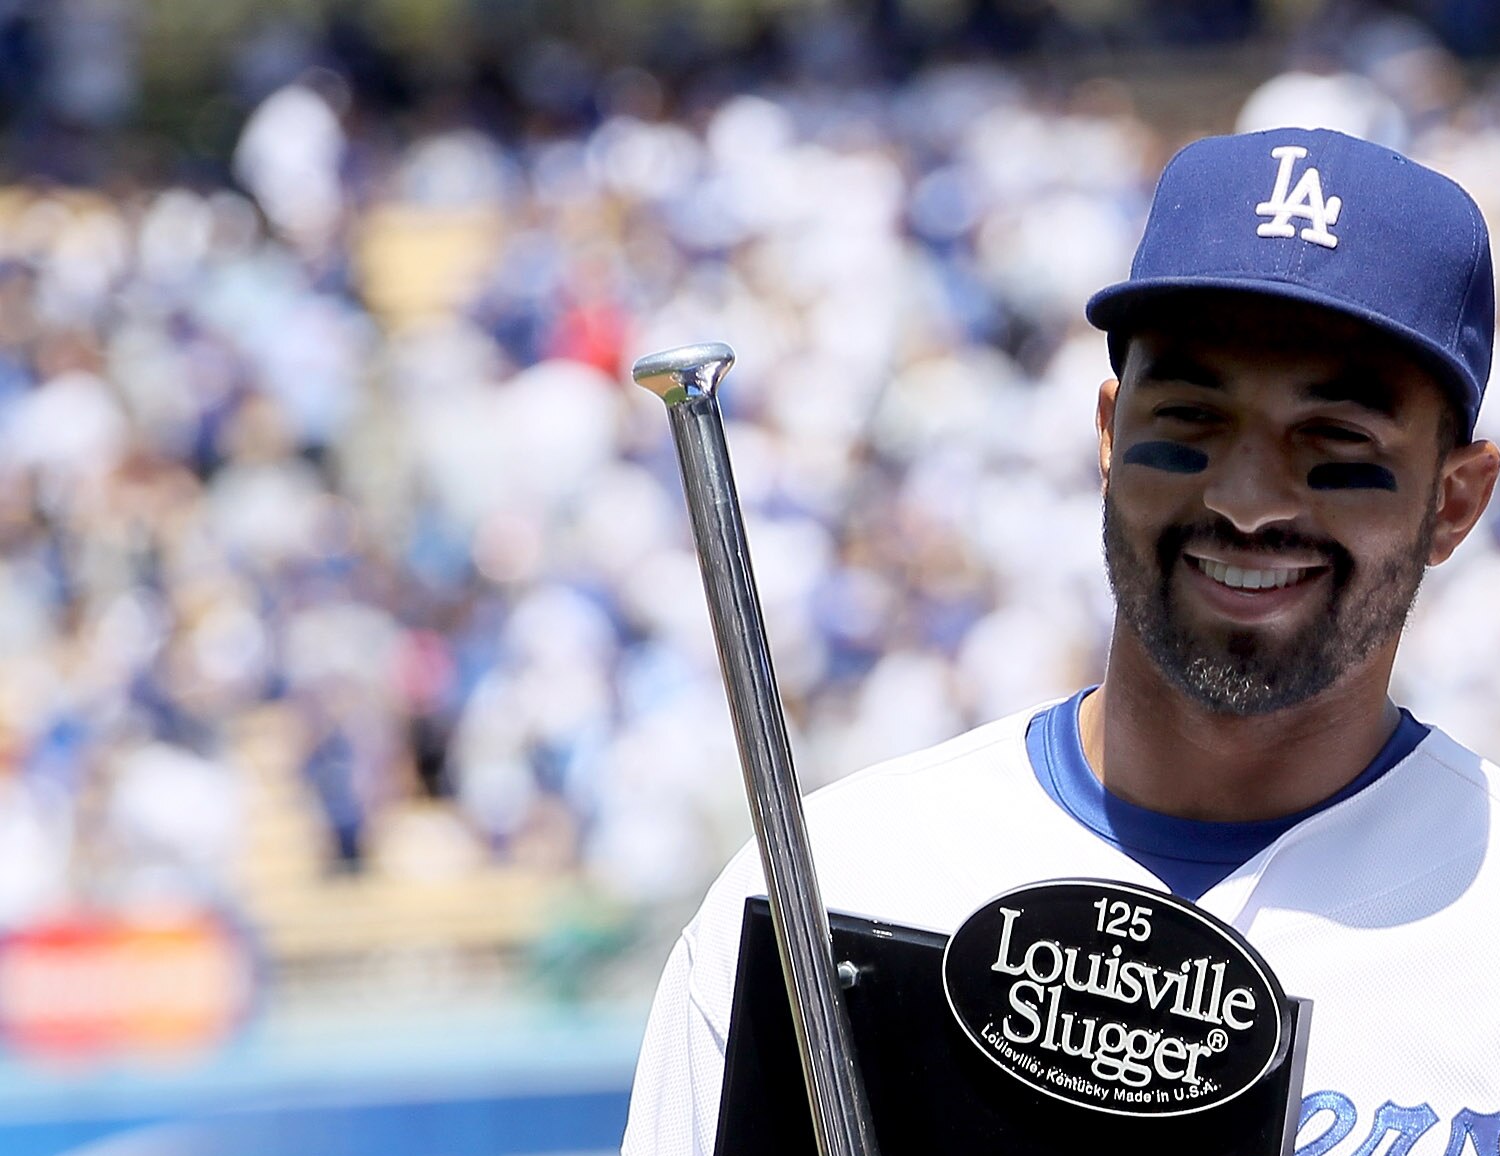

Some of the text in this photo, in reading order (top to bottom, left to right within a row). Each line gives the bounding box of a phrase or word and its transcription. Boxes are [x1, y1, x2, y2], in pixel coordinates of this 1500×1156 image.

[1256, 146, 1342, 249] LA
[1093, 898, 1152, 942] 125
[991, 908, 1256, 1030] Louisville
[1046, 1067, 1109, 1101] Kentucky
[1114, 1089, 1152, 1103] Made
[1156, 1091, 1169, 1102] in
